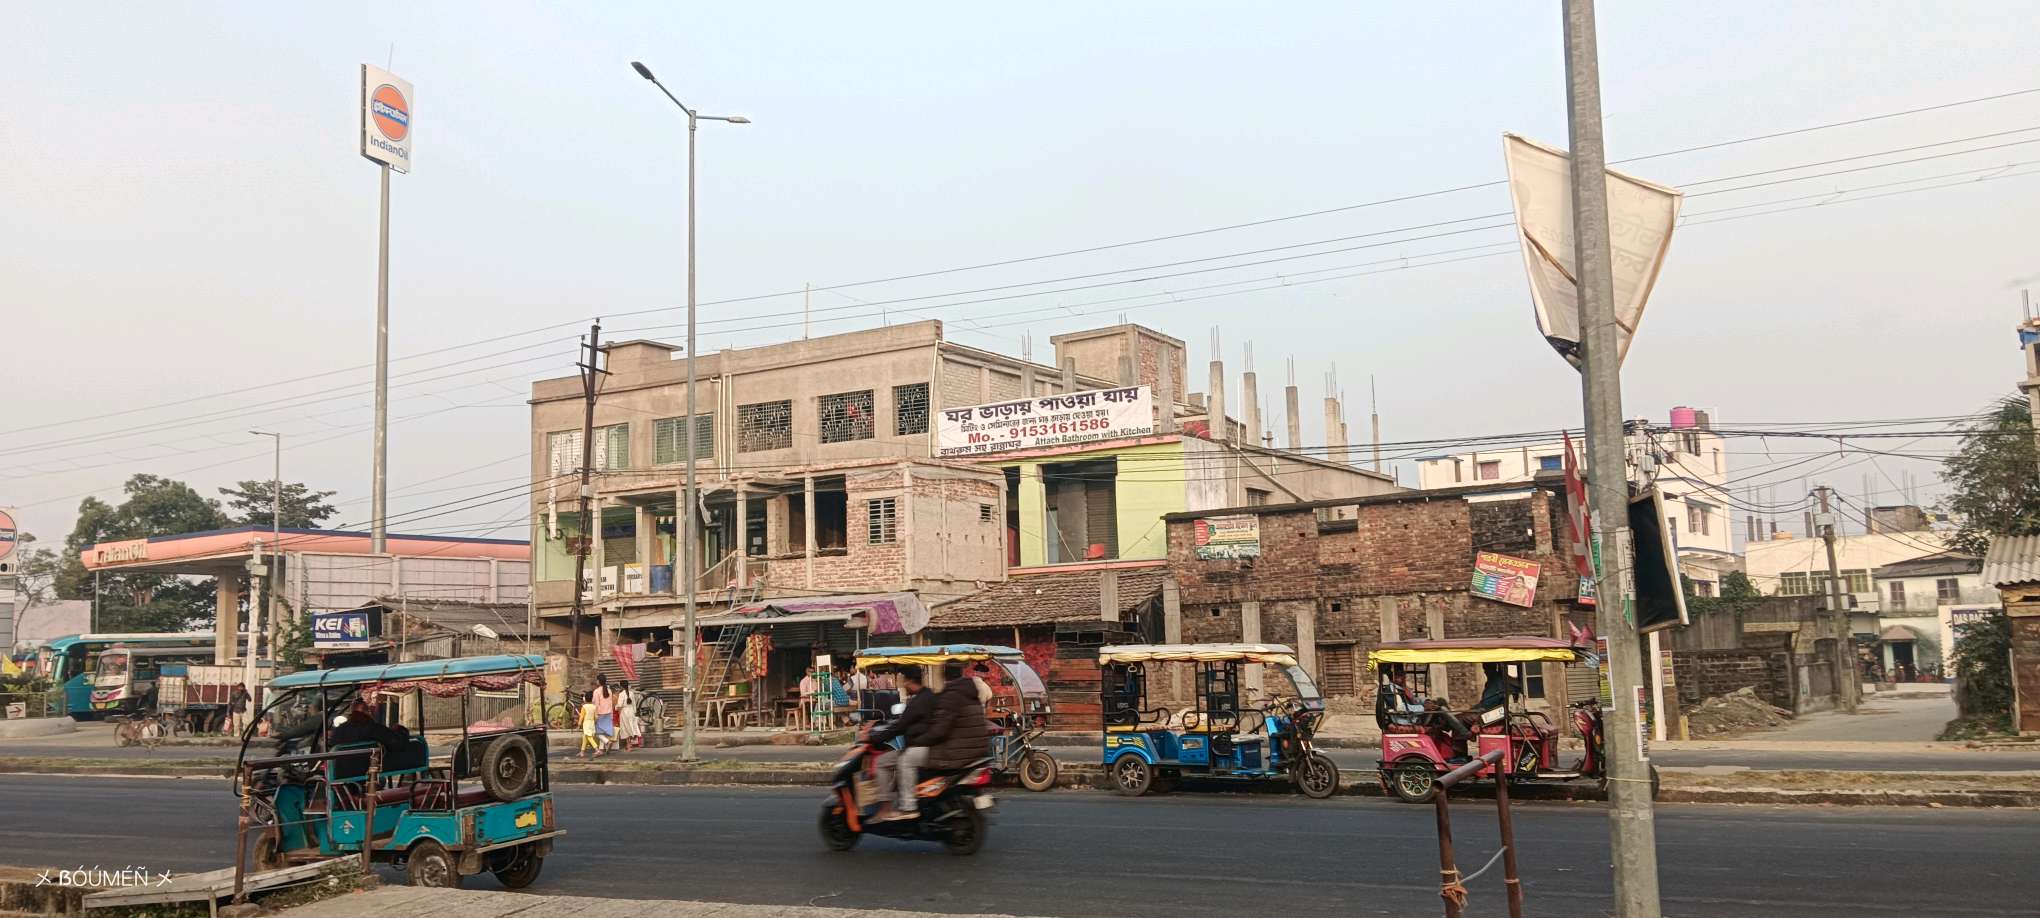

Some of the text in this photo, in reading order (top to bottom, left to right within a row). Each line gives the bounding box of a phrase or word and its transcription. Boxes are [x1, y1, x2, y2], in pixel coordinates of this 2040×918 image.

[370, 135, 408, 160] IndianOil
[945, 387, 1139, 423] ঘর ভাড়ায় পাওয়া যায়
[968, 432, 995, 444] Mo.
[1009, 417, 1110, 439] 9153161586
[1035, 426, 1151, 446] Attach Bathroom with Kitchen
[315, 618, 342, 630] KEI
